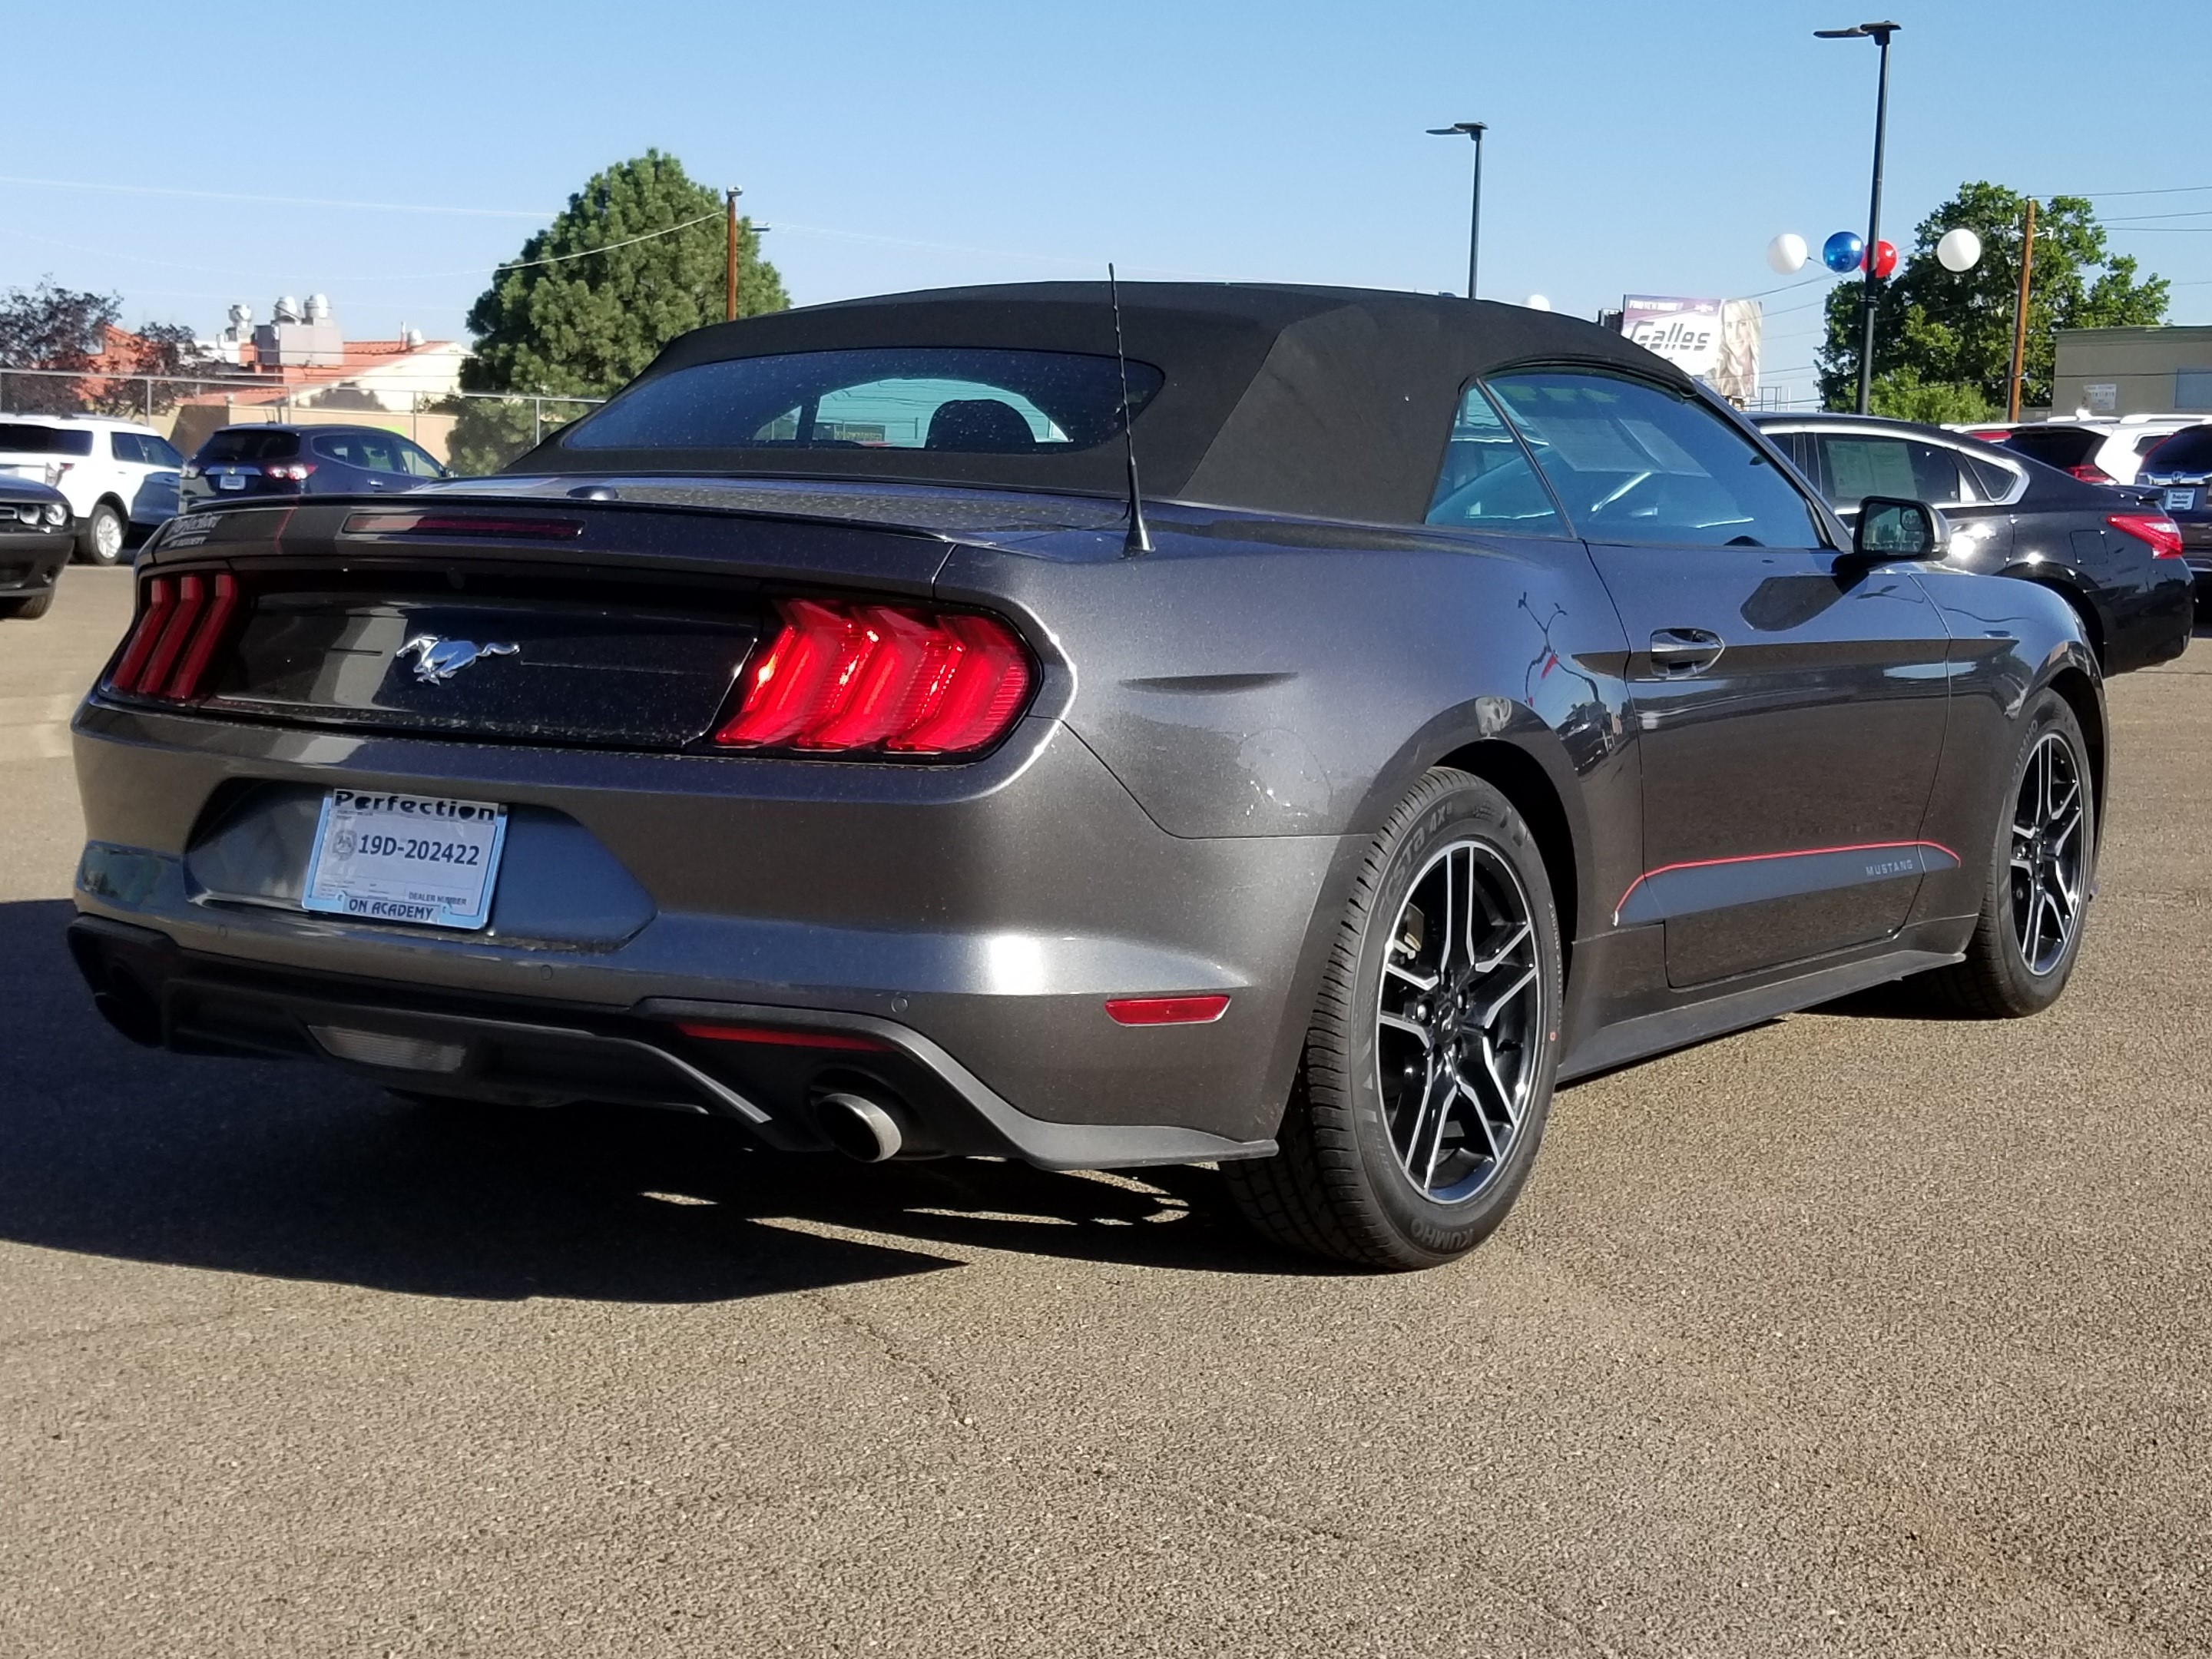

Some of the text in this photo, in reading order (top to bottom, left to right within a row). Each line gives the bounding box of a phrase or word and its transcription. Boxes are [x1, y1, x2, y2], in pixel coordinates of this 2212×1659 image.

[1630, 320, 1710, 351] Galles
[334, 790, 496, 821] Perfection
[358, 834, 480, 866] 19D-202422
[1865, 859, 1913, 876] MUSTANG
[349, 899, 434, 920] ON ACADEMY
[409, 891, 467, 906] DEALER NUMBER
[1410, 1218, 1474, 1250] KUMHO
